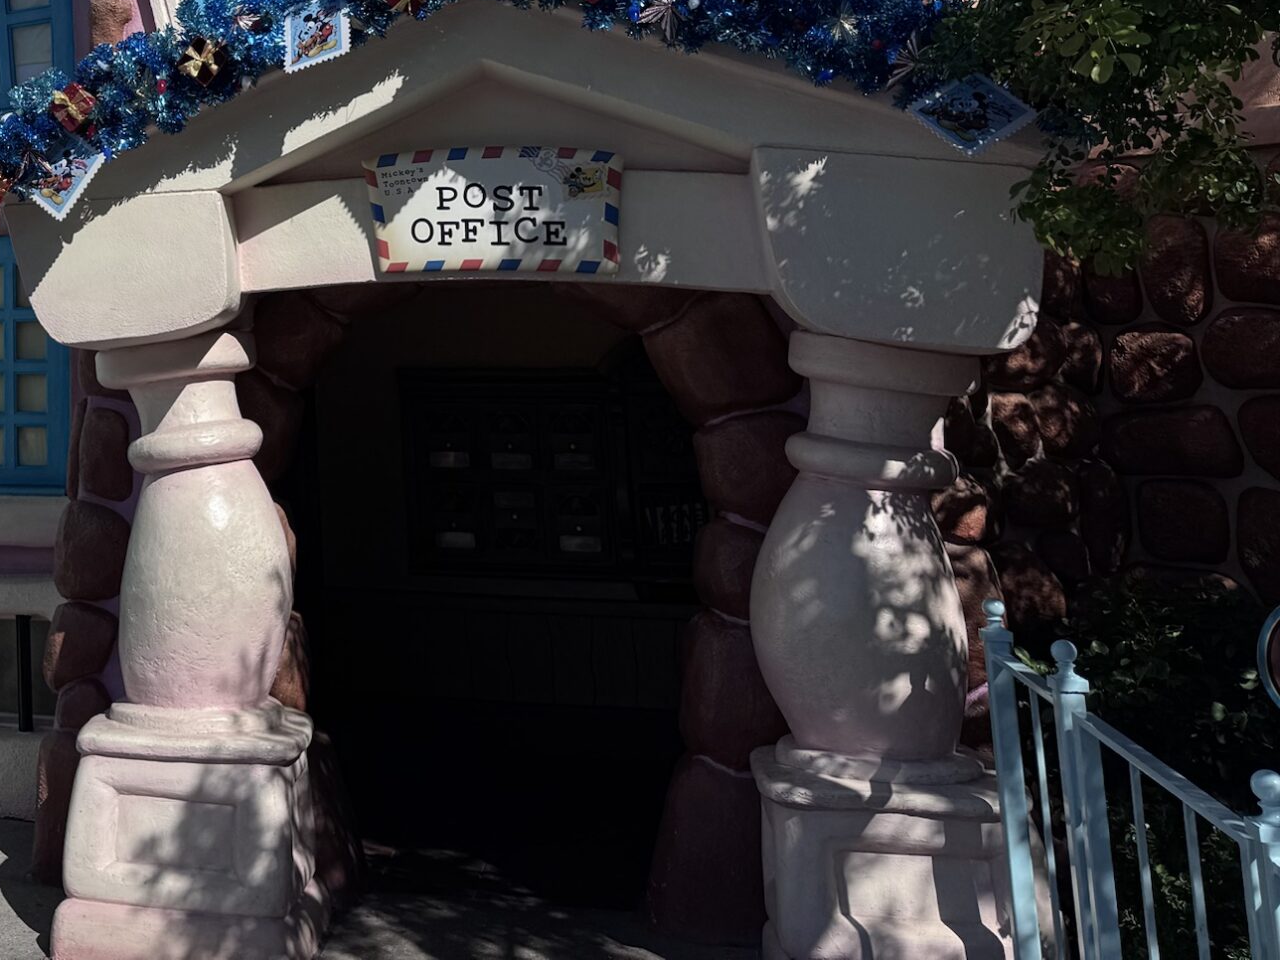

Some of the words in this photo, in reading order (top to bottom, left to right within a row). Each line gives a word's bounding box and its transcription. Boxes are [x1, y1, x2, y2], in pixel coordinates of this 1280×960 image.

[381, 167, 424, 179] Mickey's
[383, 177, 428, 188] Toontown
[436, 182, 543, 212] POST
[411, 217, 567, 246] OFFICE
